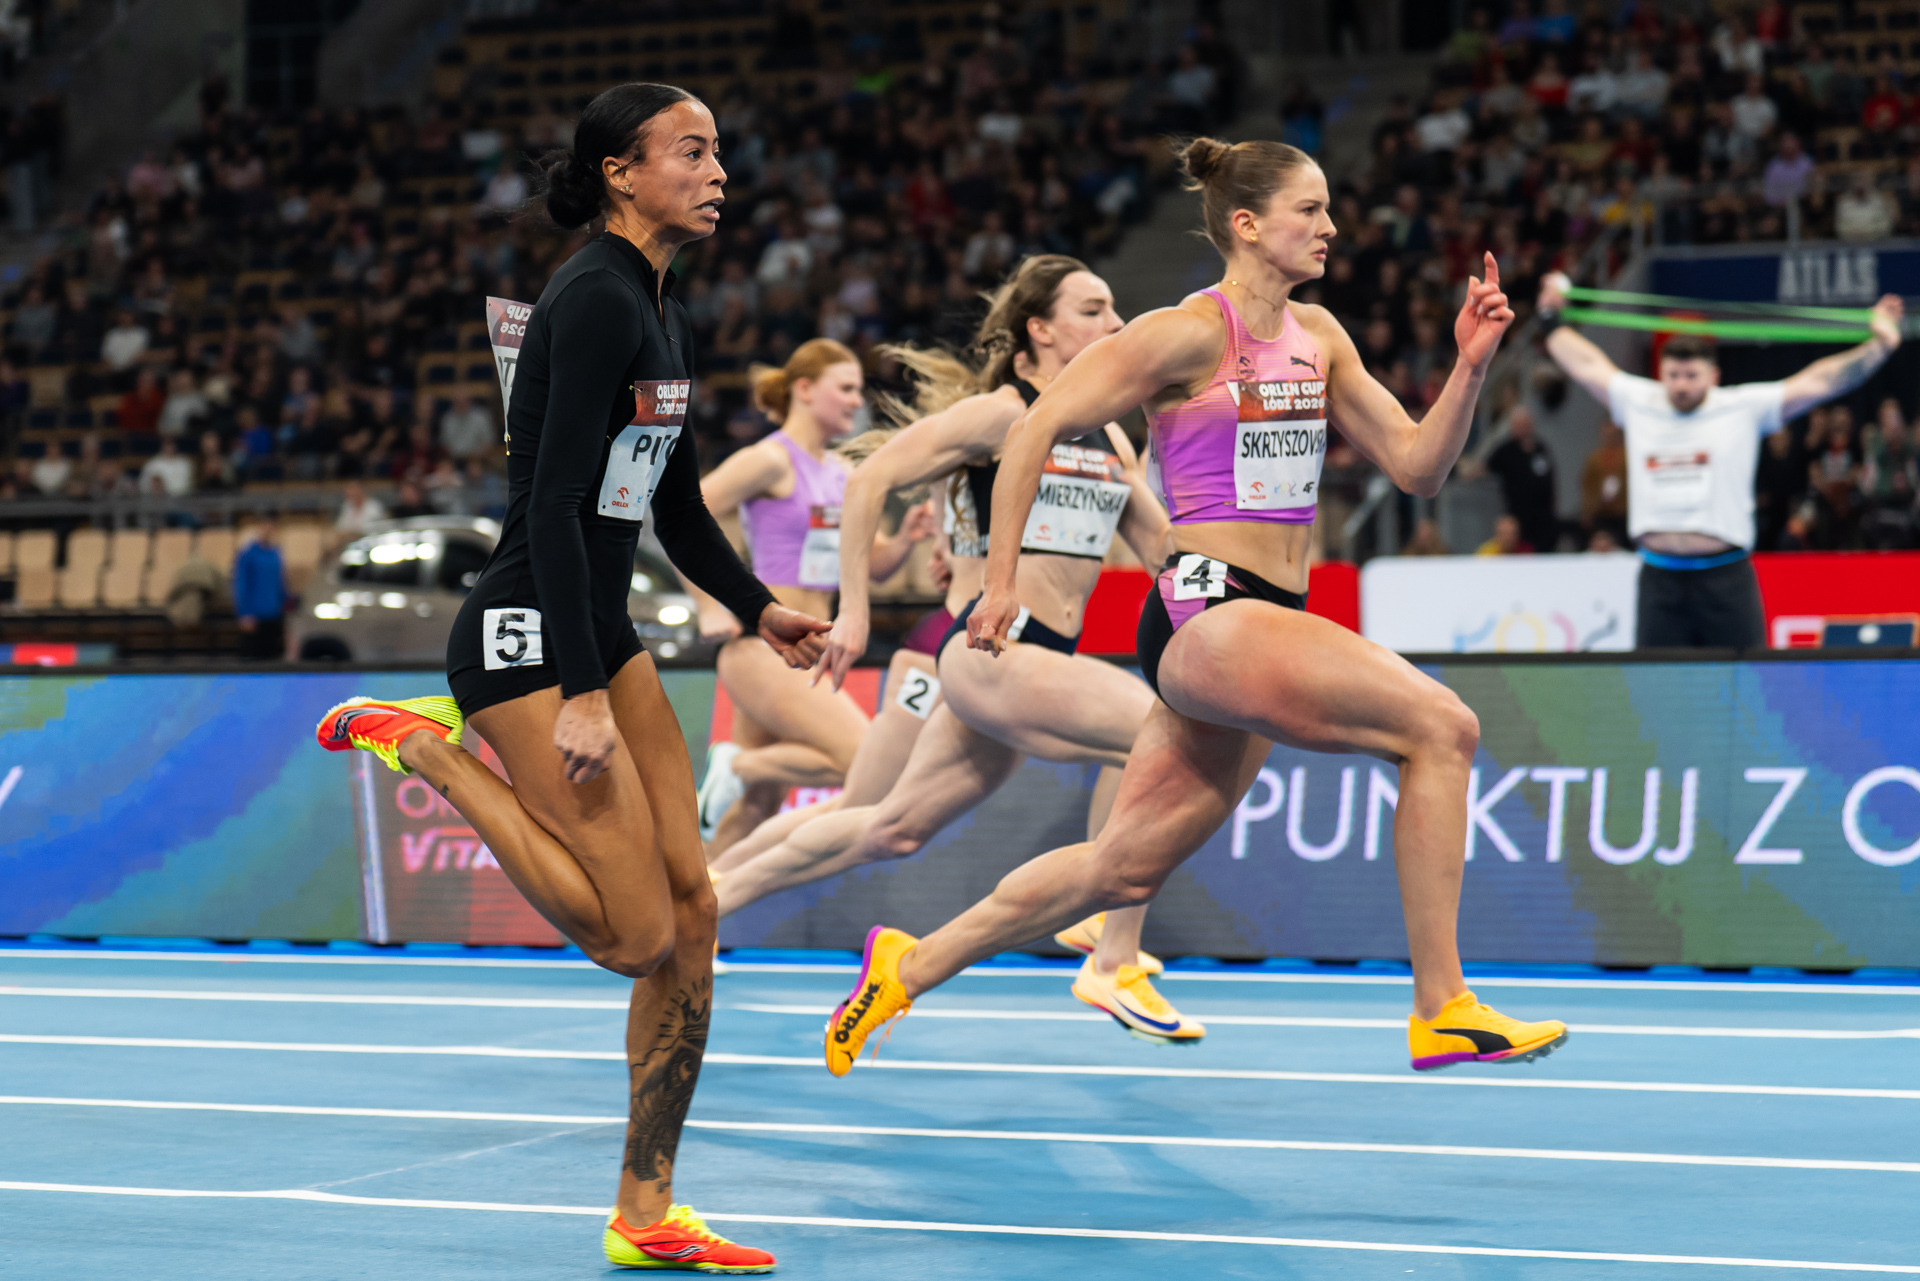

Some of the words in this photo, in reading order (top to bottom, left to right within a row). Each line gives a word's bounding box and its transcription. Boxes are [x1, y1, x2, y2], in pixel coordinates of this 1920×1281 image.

[657, 384, 679, 399] ORLEN
[1258, 382, 1300, 397] ORLEN
[1301, 380, 1325, 396] CUP
[1294, 397, 1326, 410] 2026
[611, 500, 629, 508] ORLEN
[1183, 559, 1213, 592] 4
[495, 613, 528, 663] 5
[904, 678, 929, 712] 2
[1733, 767, 1808, 864] Z
